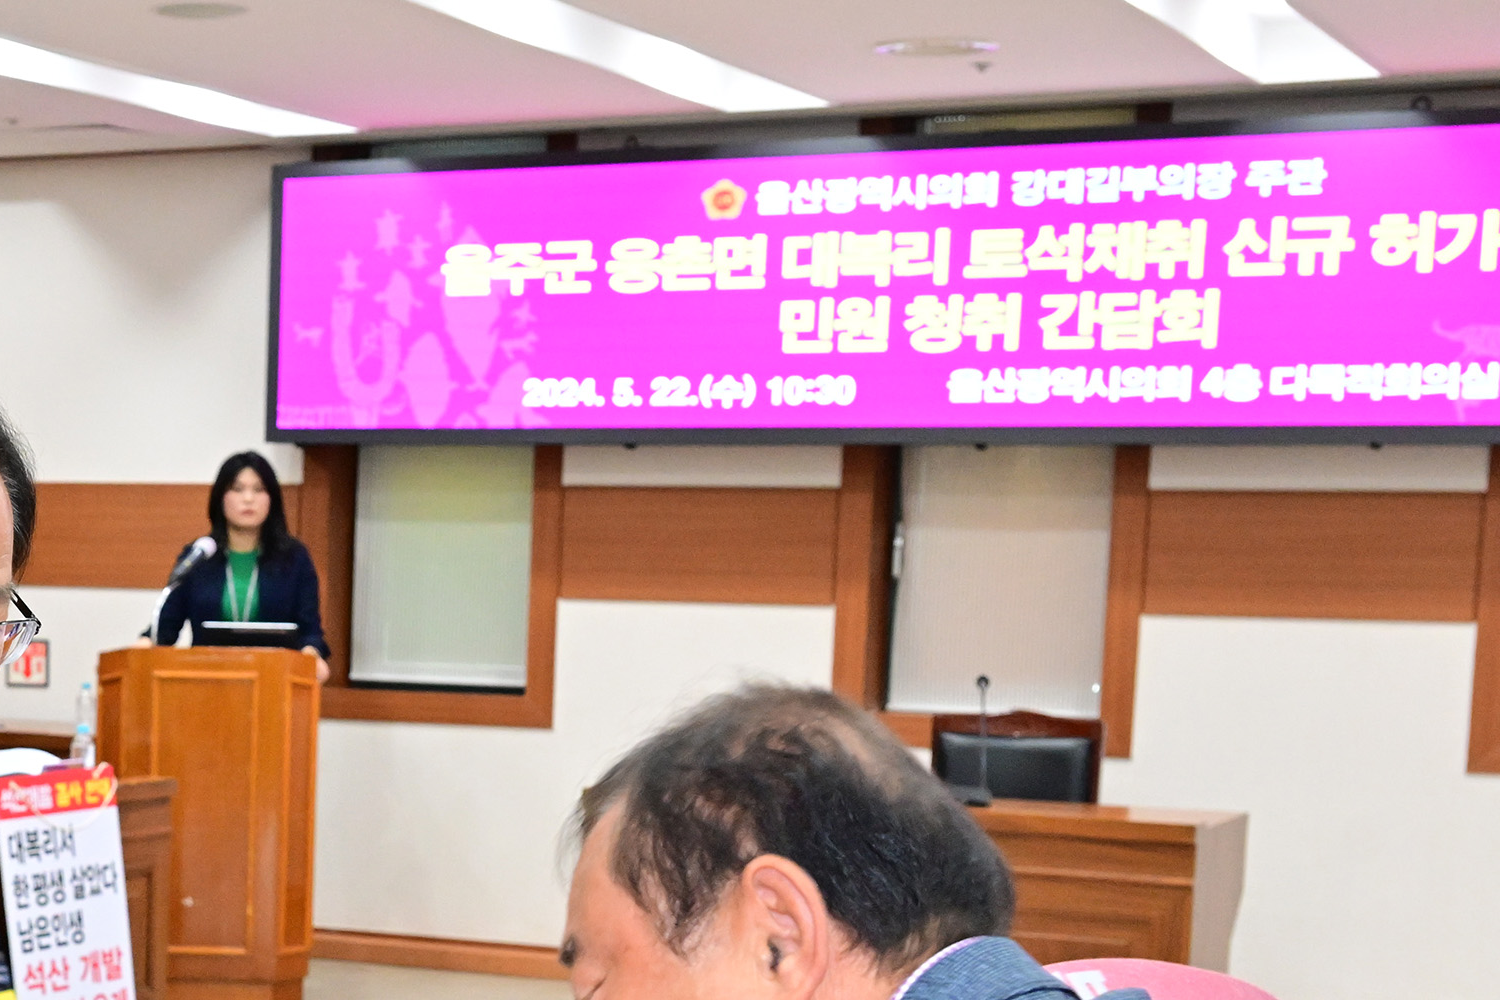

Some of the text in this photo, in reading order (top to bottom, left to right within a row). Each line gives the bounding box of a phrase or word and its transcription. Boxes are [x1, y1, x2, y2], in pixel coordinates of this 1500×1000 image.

[755, 170, 999, 215] 울산광역시의회
[1245, 157, 1328, 198] 주관
[440, 209, 1500, 297] 울주군 웅촌면 대복리 토석채취 신규 허가
[779, 287, 1221, 354] 민원 청취 간담회
[522, 373, 856, 409] 2024. 5. 22.(수) 10:30
[947, 361, 1500, 403] 울산광역시의회 4층 다목적회의실
[8, 824, 76, 863] 대복리서
[14, 861, 118, 909] 한평생 살았다
[17, 910, 85, 953] 남은인생
[24, 947, 123, 995] 석산 개발
